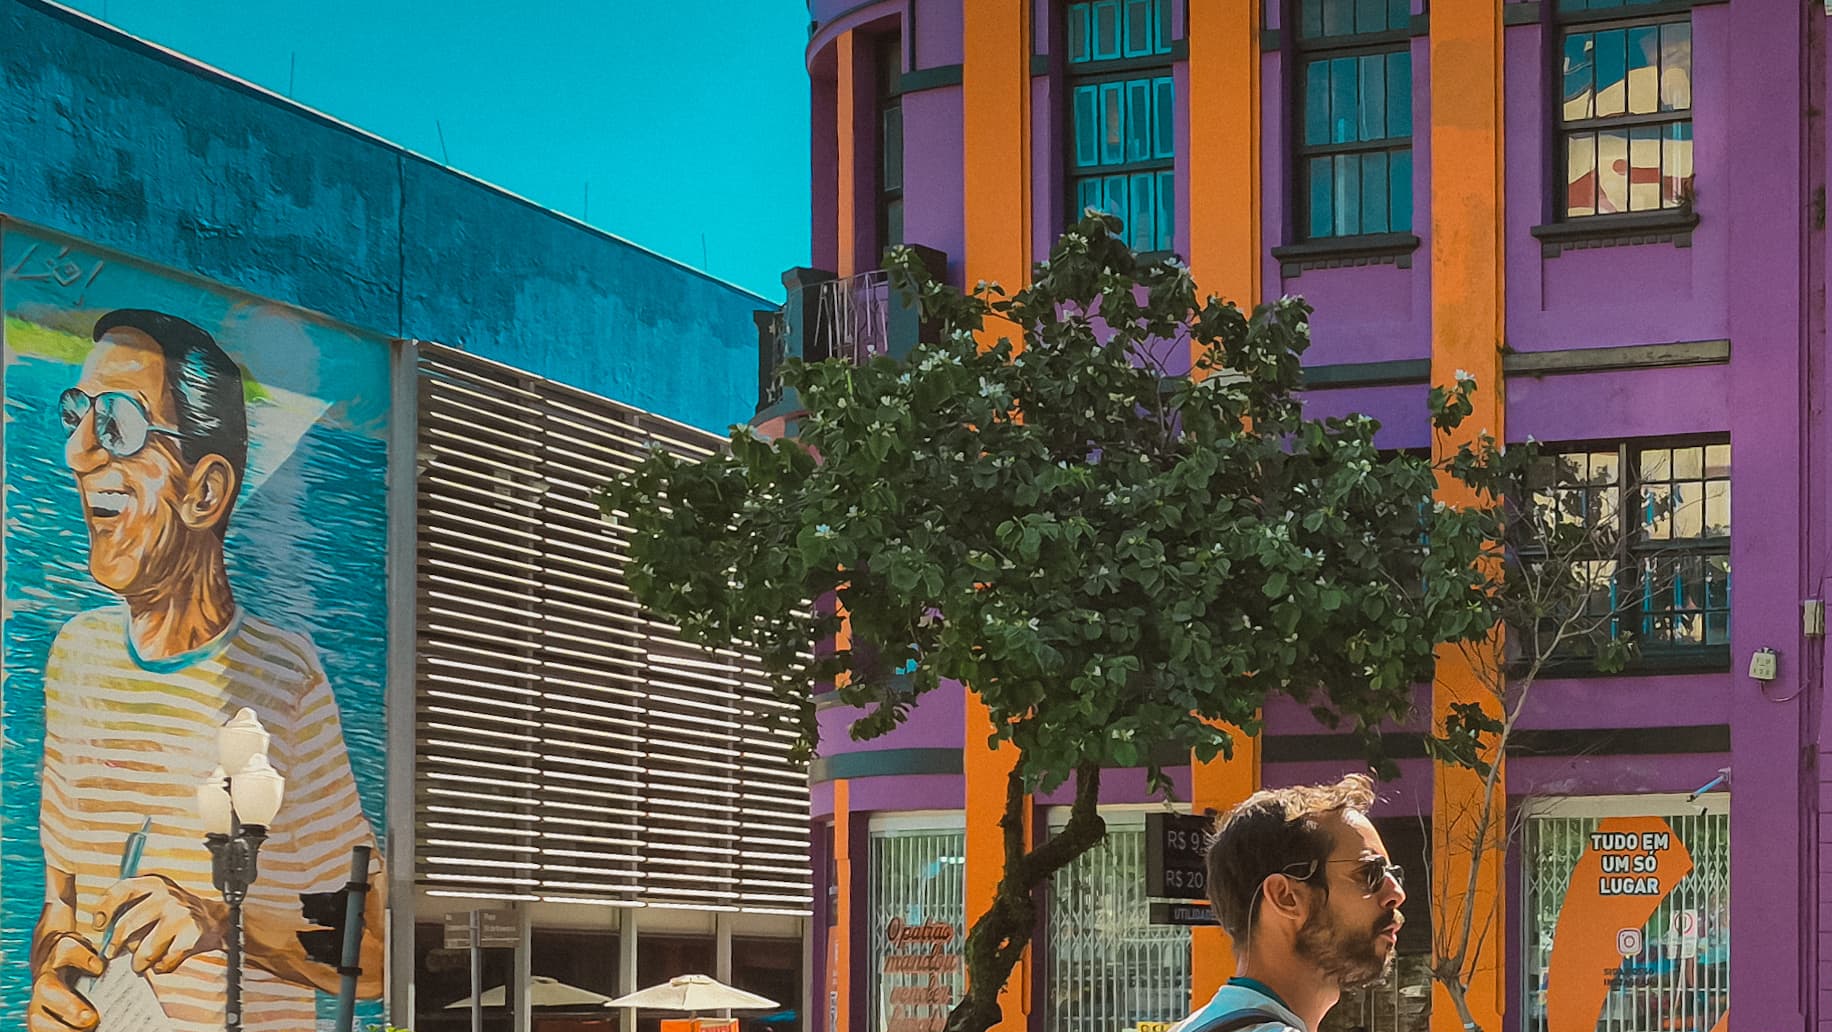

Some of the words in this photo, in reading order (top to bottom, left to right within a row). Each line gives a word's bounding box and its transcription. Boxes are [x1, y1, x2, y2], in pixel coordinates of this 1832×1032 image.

[1591, 833, 1638, 851] TUDO
[1642, 833, 1669, 851] EM
[1602, 855, 1630, 873] UM
[1633, 850, 1657, 873] SÓ
[1600, 877, 1659, 895] LUGAR
